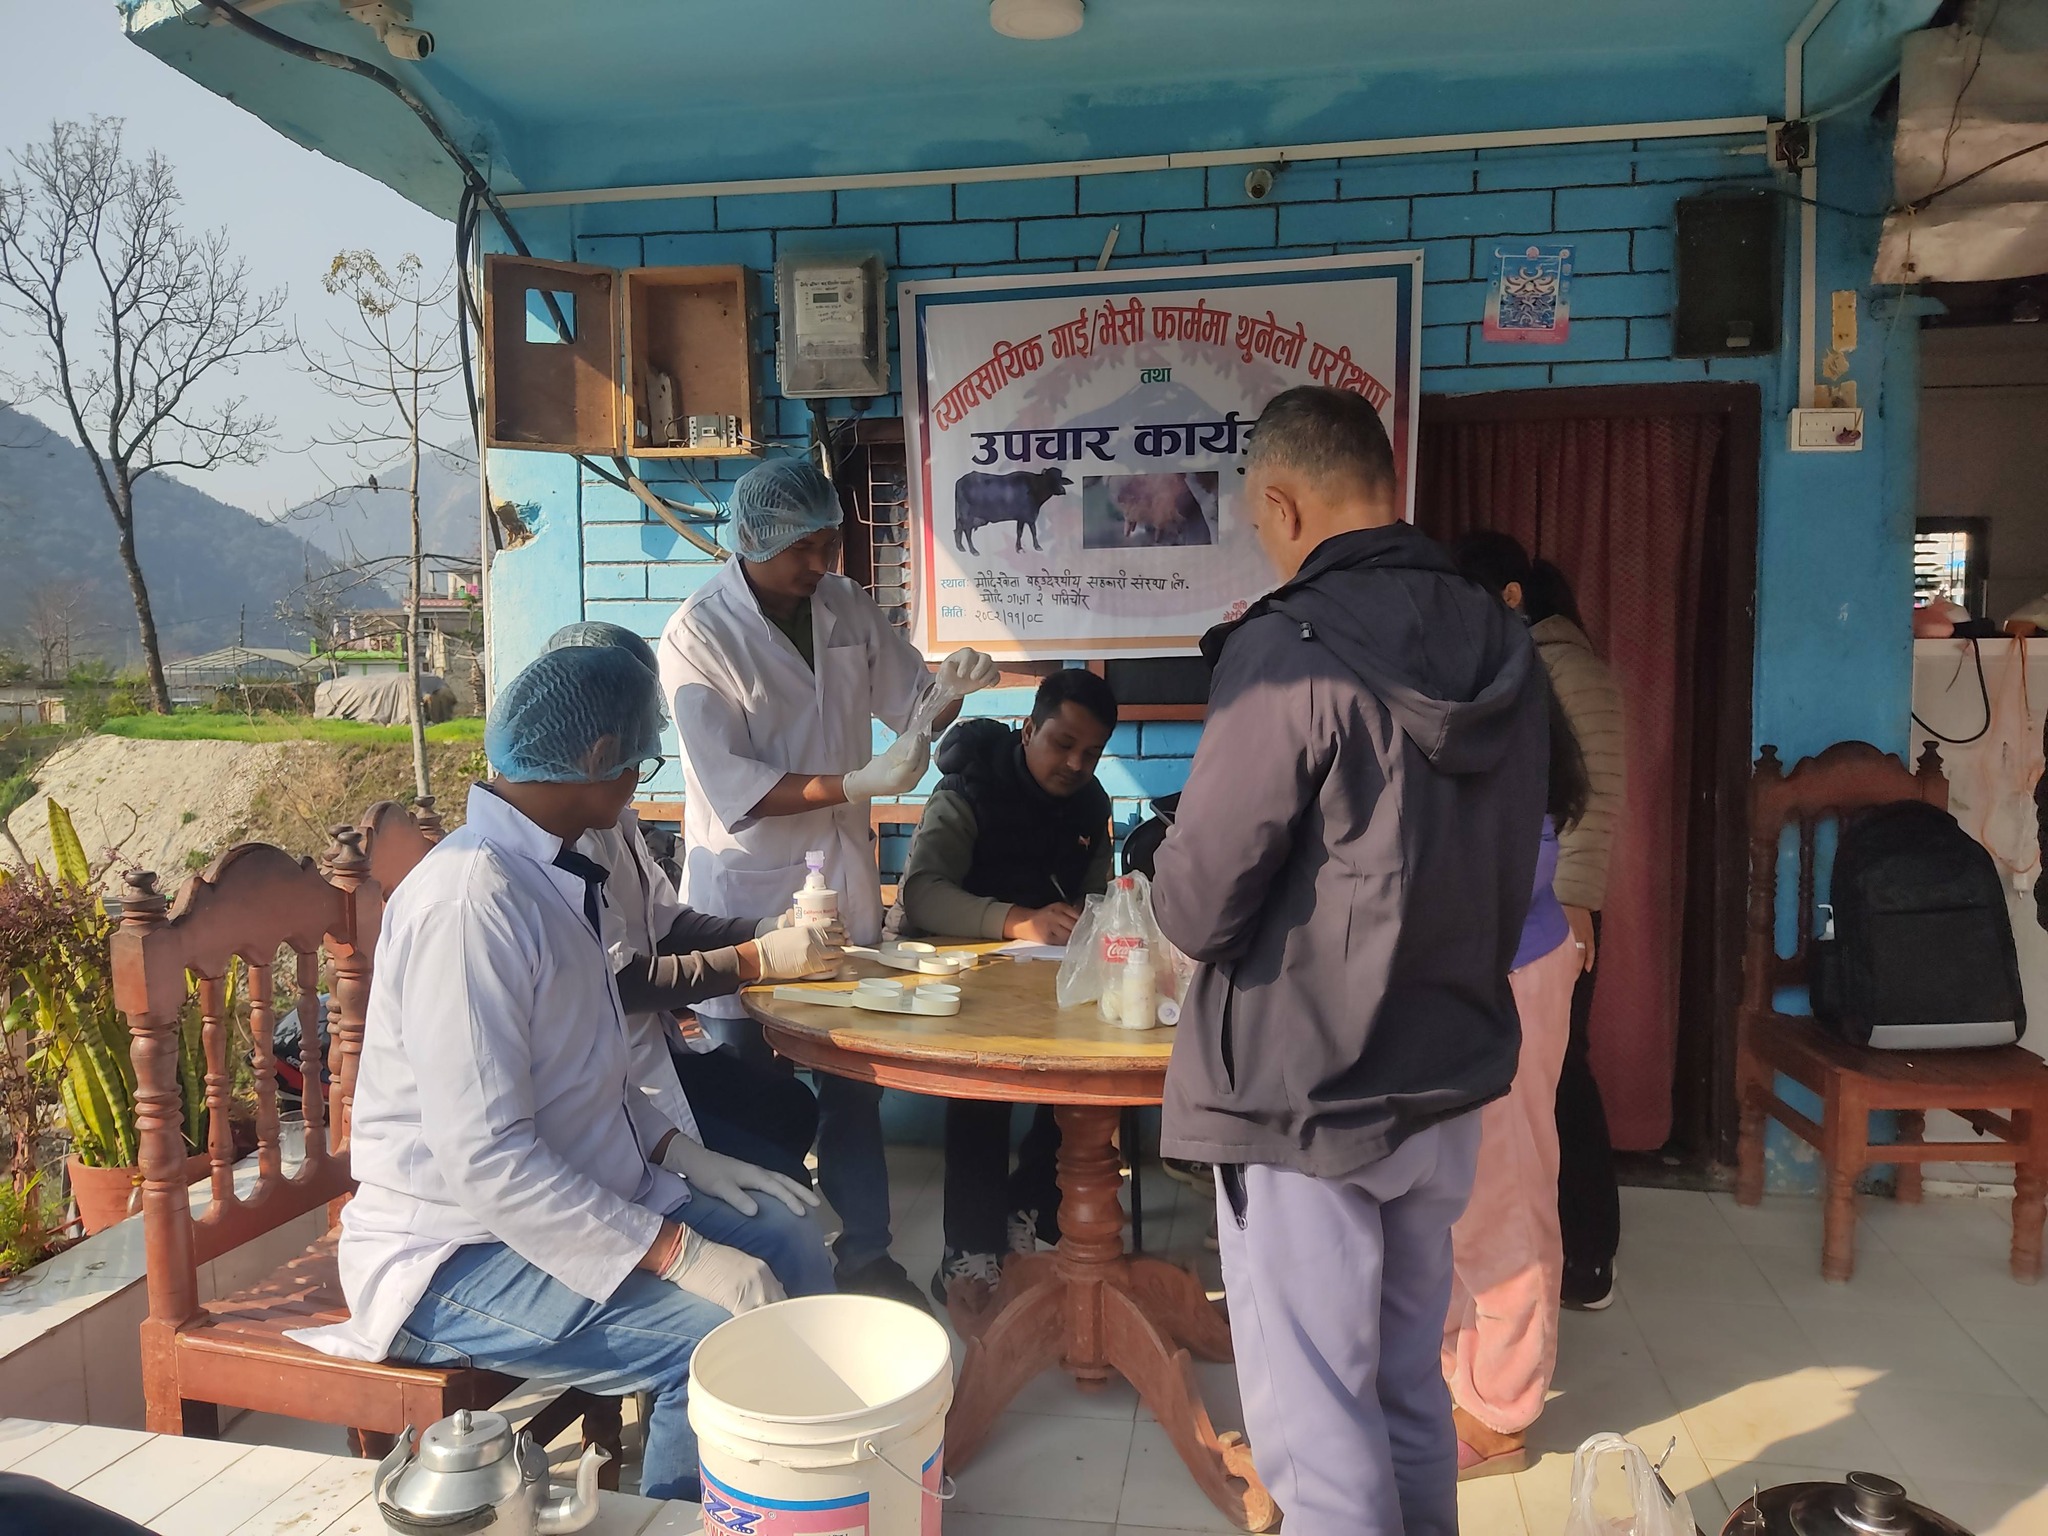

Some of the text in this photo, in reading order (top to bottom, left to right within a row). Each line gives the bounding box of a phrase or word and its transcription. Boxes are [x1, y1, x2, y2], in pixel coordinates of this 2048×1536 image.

[1048, 297, 1145, 359] गाई/भैसी
[1152, 298, 1232, 346] फार्ममा
[1235, 310, 1307, 369] थुनेलो
[1140, 367, 1172, 384] तथा
[971, 411, 1256, 474] उपचार कार्य
[941, 579, 968, 589] स्थान:
[1086, 570, 1128, 590] सहकारी
[1131, 574, 1168, 590] संस्था
[942, 606, 967, 618] मिति:
[700, 1480, 763, 1535] ZZ
